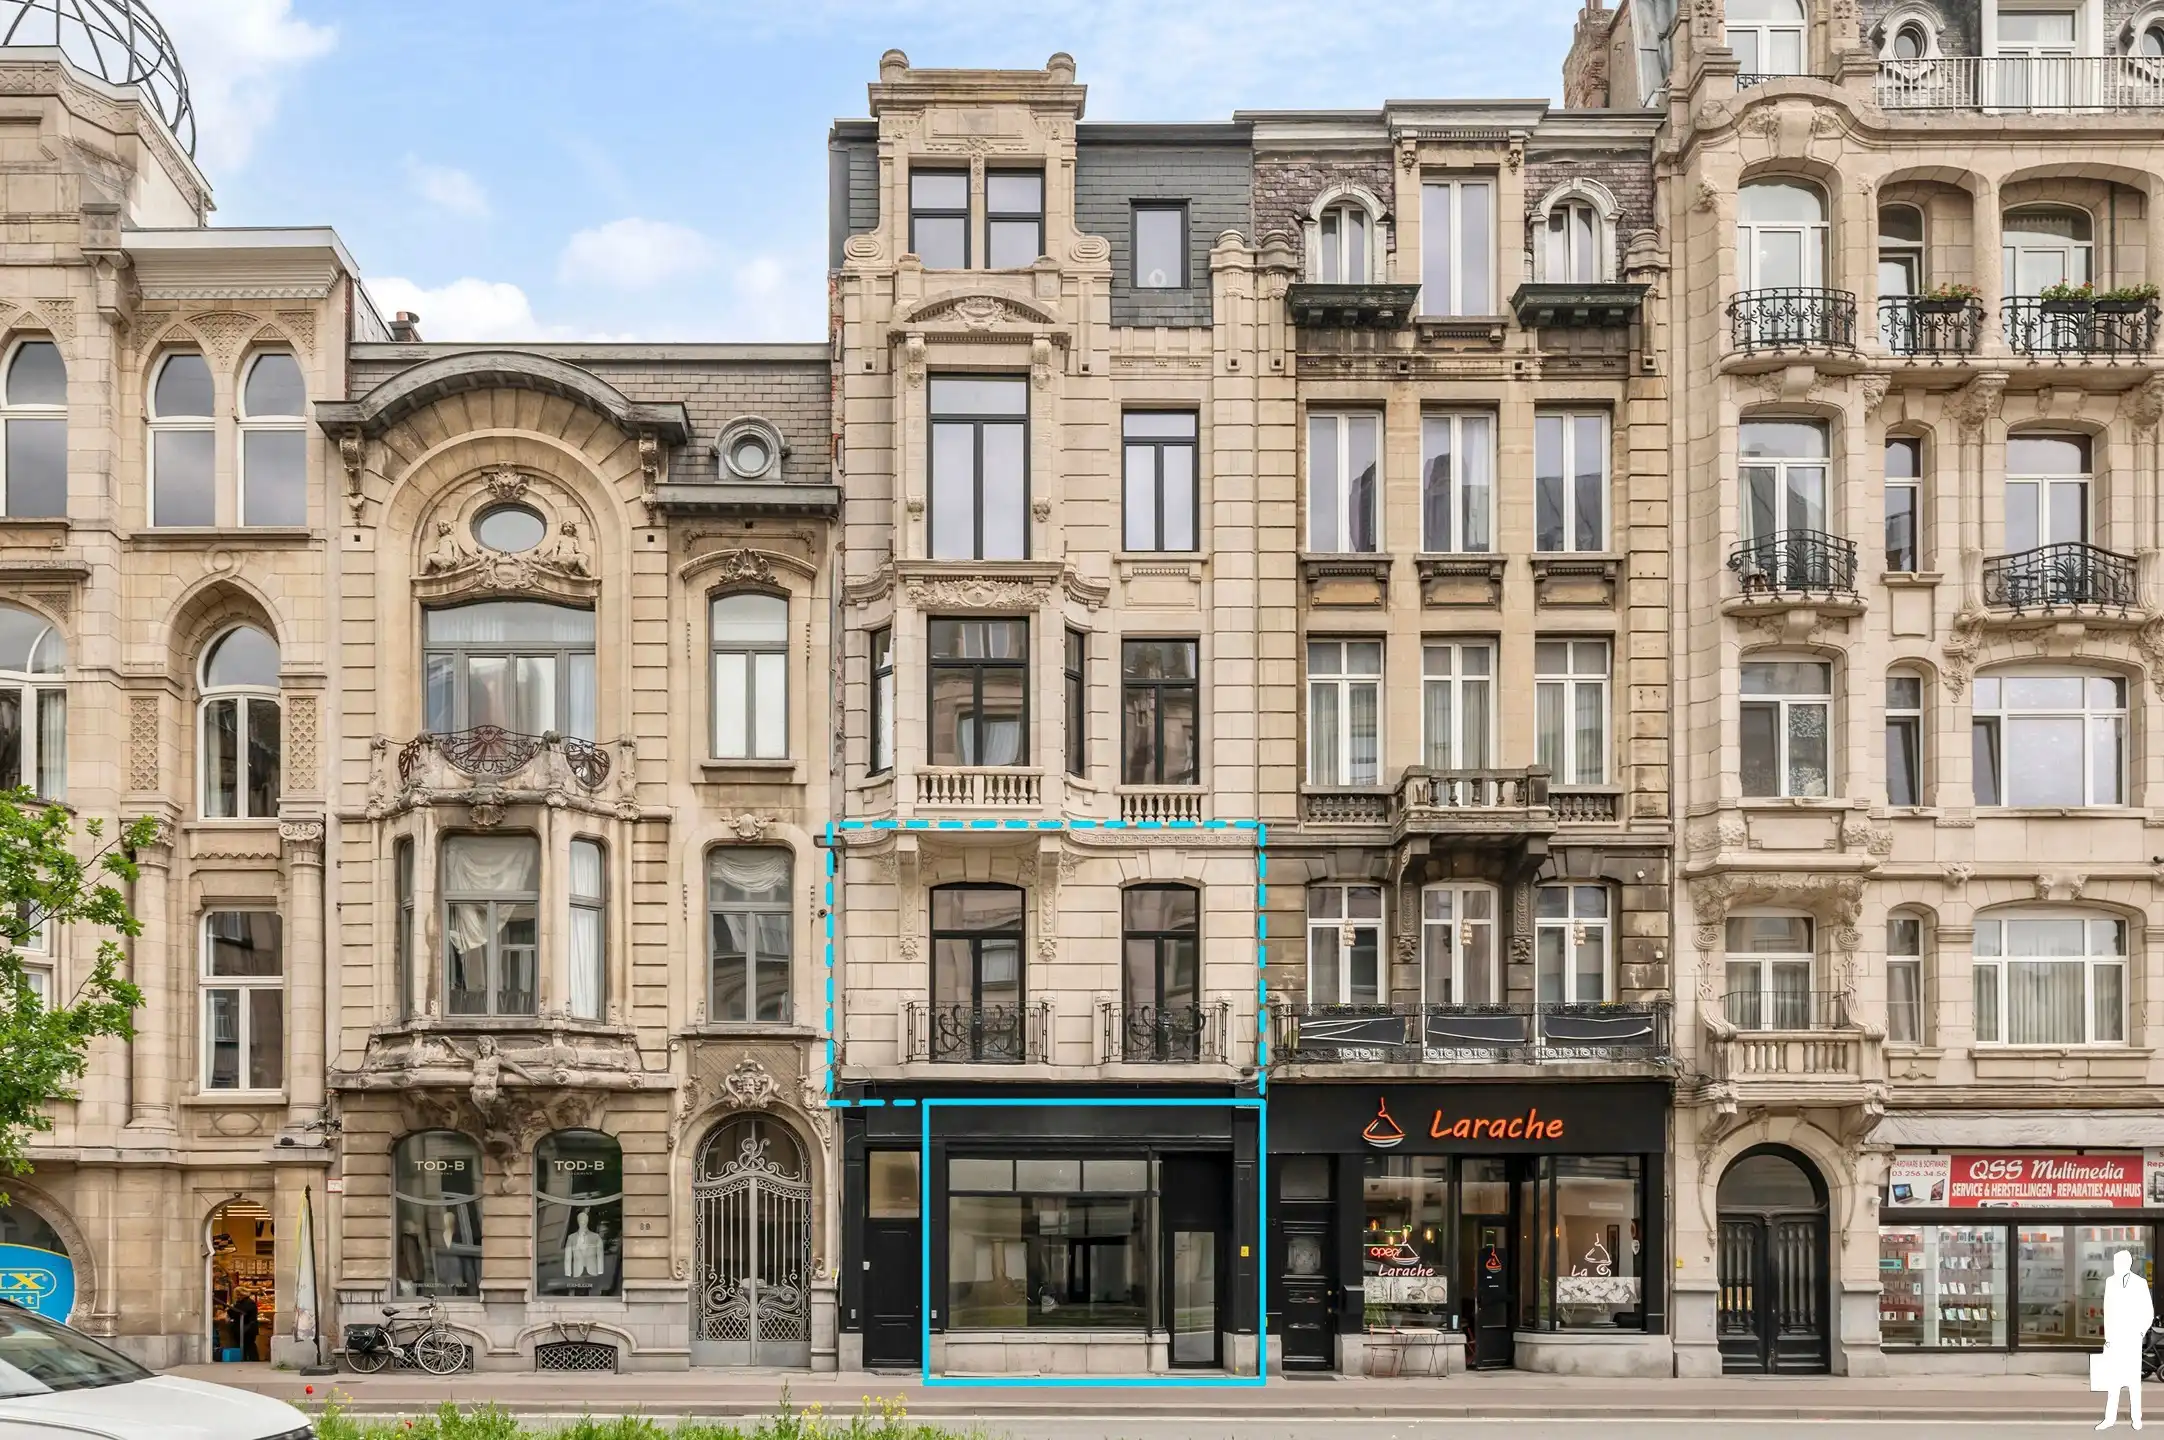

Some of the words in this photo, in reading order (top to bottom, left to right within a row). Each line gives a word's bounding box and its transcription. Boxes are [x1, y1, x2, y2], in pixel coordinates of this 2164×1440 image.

[1430, 1107, 1564, 1140] Larache
[414, 1160, 465, 1171] TOD-B
[554, 1160, 605, 1171] TOD-B
[1969, 1159, 2023, 1180] QSS
[2030, 1159, 2125, 1180] Multimedia
[1952, 1182, 1984, 1197] SERVICE
[1984, 1182, 1990, 1197] &
[1991, 1182, 2053, 1197] HERSTELLINGEN
[2057, 1182, 2104, 1197] REPARATIES
[2104, 1182, 2123, 1197] AAN
[2123, 1182, 2142, 1197] HUIS
[1378, 1263, 1434, 1277] Larache
